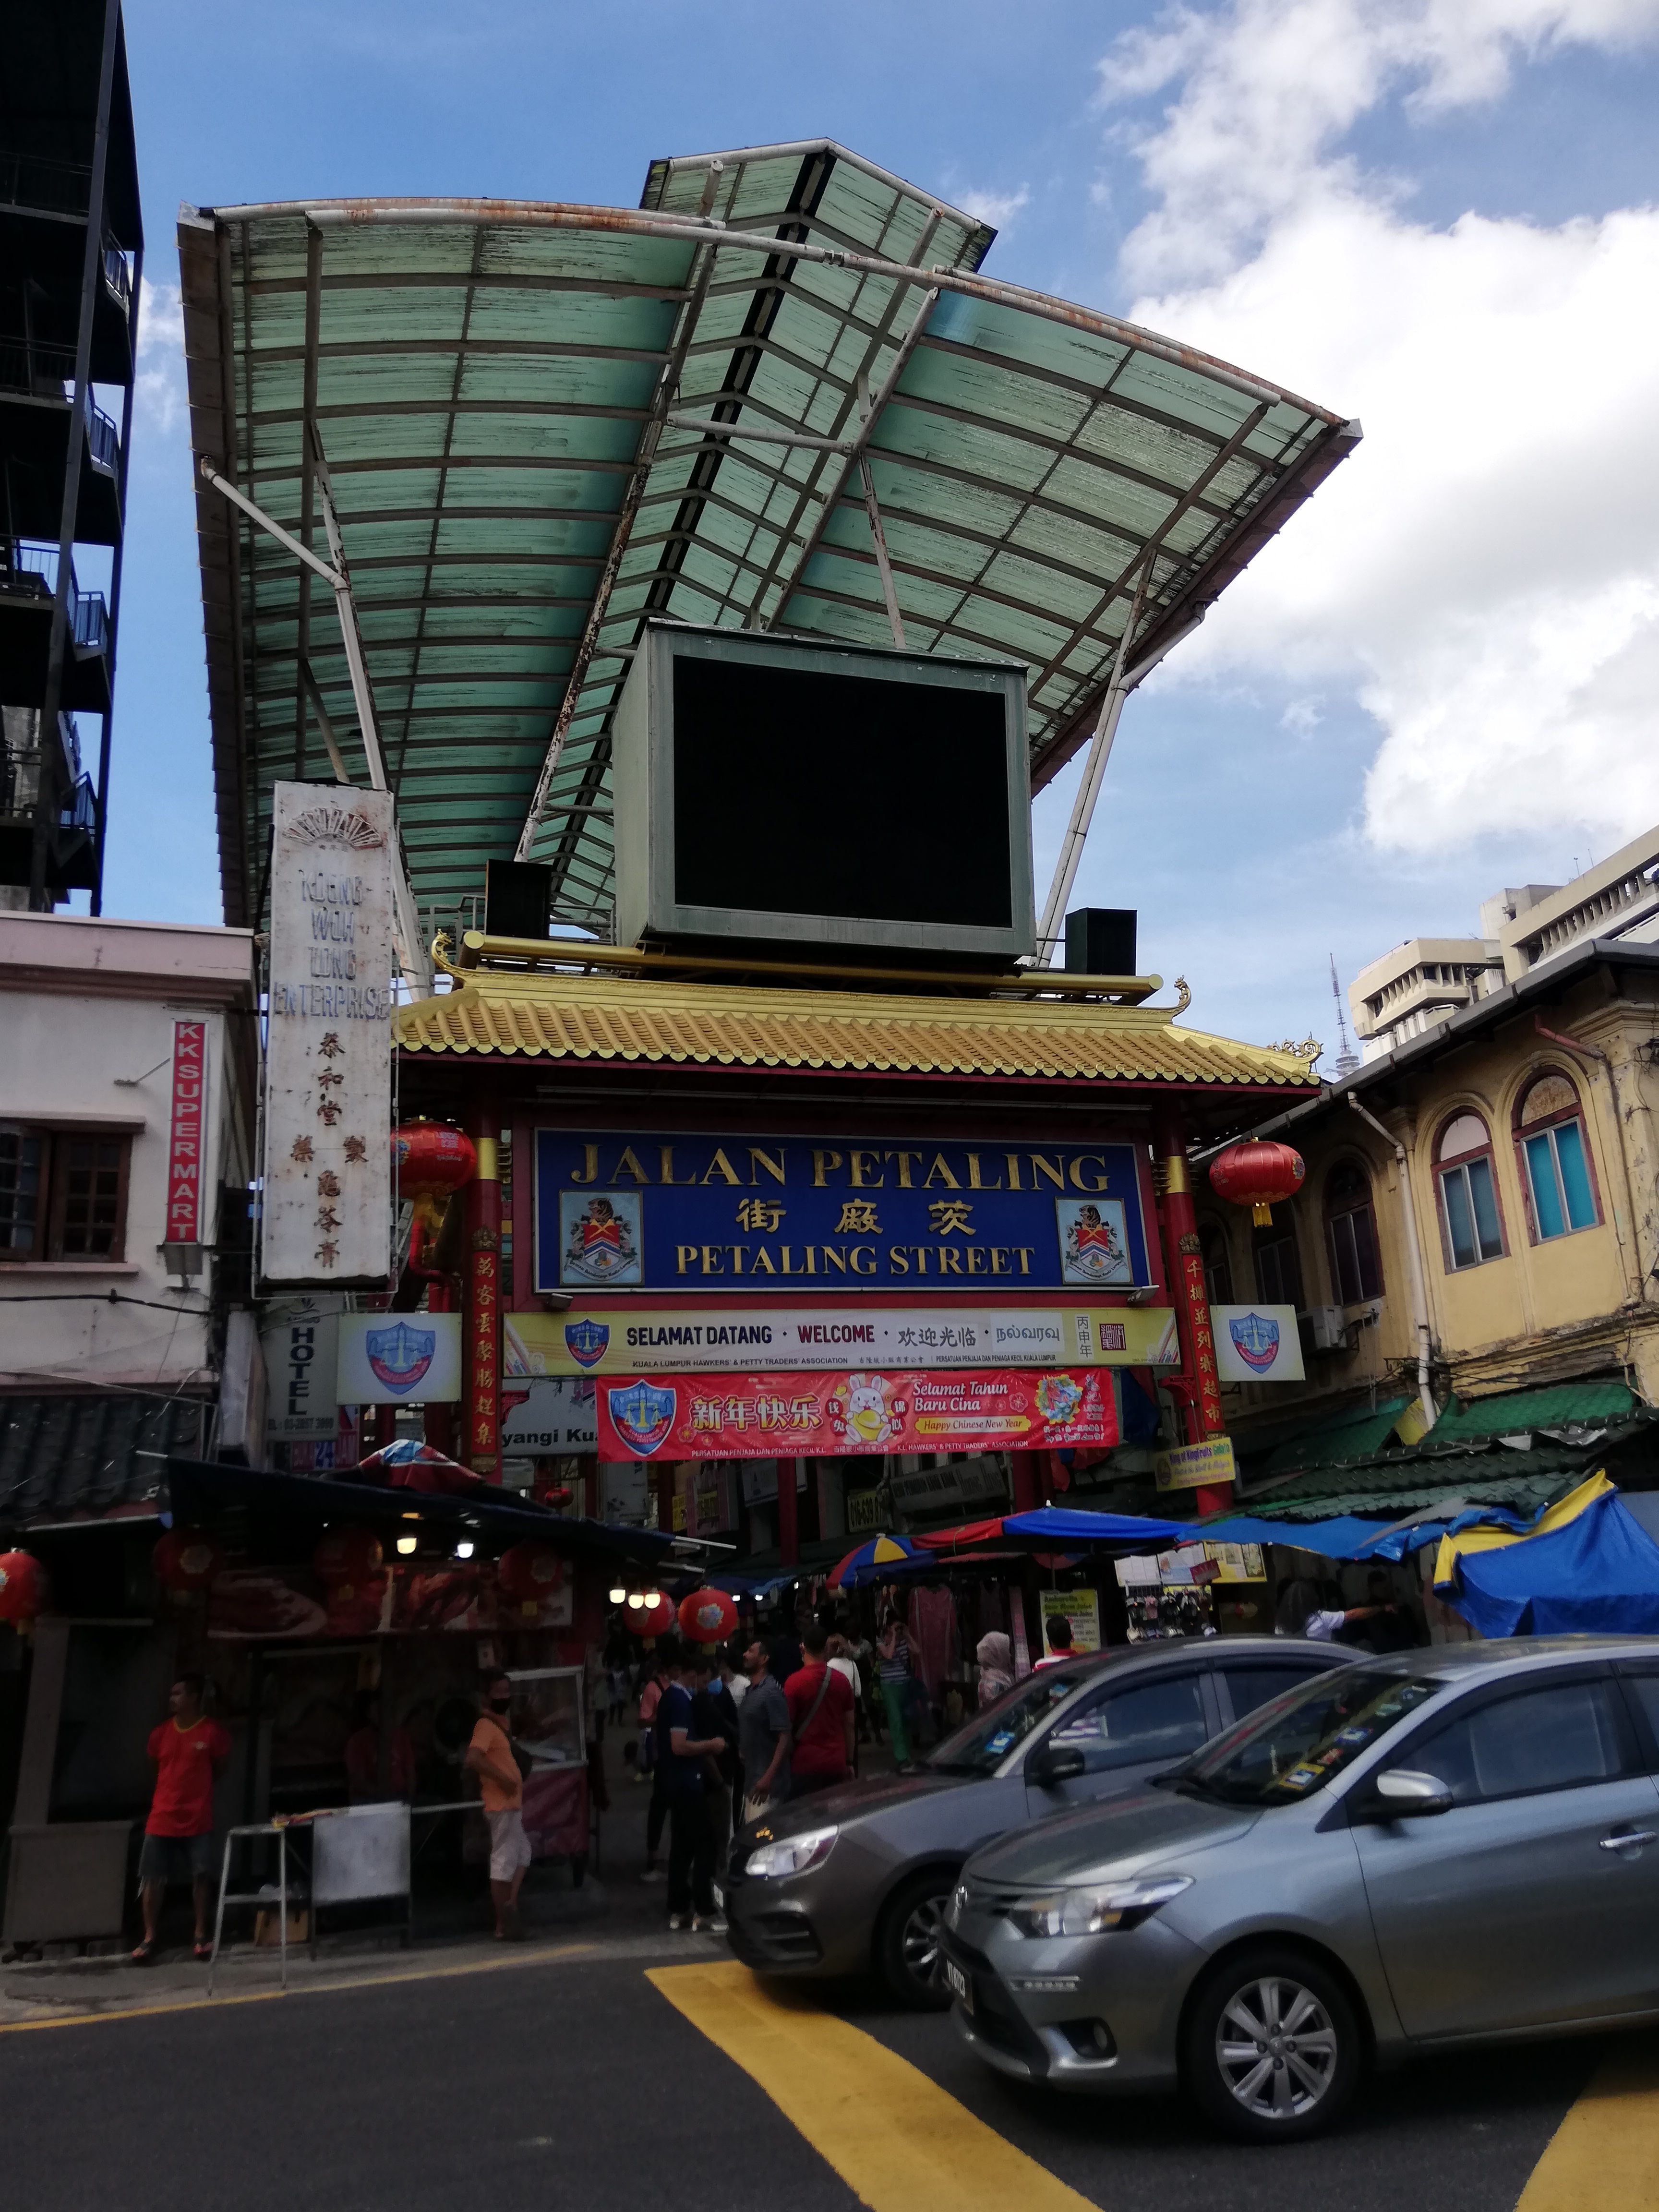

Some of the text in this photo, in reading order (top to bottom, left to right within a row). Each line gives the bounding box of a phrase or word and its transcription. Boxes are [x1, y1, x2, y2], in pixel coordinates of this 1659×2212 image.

[273, 982, 390, 1020] ENTERPRISE
[571, 1143, 1110, 1192] JALAN PETALING
[675, 1245, 1035, 1275] PETALING STREET
[627, 1324, 876, 1346] SELAMAT DATANG WELCOME
[898, 1326, 976, 1347] 欢迎光临
[996, 1324, 1060, 1343] நல்வரவு
[1076, 1316, 1093, 1358] 丙申年
[741, 1358, 763, 1366] PETTY
[764, 1358, 800, 1366] TRADERS'
[936, 1355, 962, 1363] PERSATUAN
[288, 1327, 315, 1416] HOTEL
[913, 1379, 1008, 1396] Selamat Tahun
[692, 1395, 822, 1431] 新年快乐
[914, 1397, 981, 1412] Baru Cina
[567, 1429, 598, 1443] Ku
[924, 1419, 1022, 1432] Happy Chinese New Year
